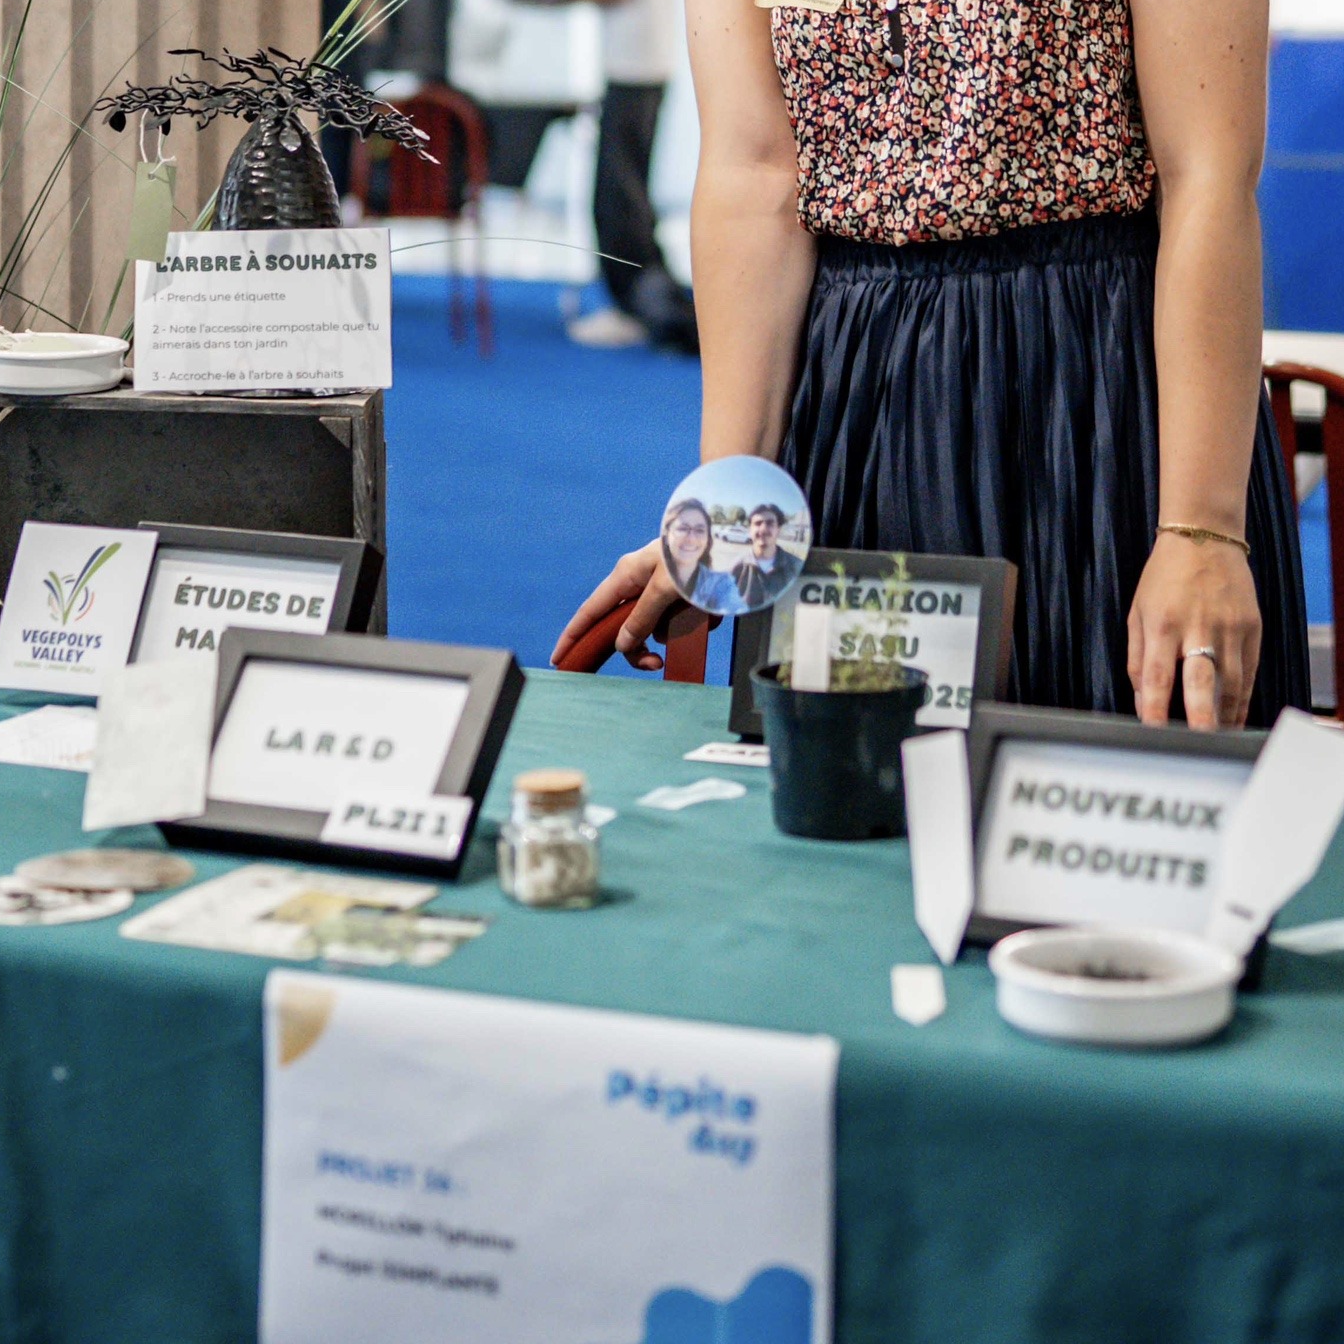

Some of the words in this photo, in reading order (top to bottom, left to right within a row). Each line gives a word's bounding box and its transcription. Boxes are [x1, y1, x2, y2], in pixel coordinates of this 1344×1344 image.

[246, 250, 260, 272] À
[265, 253, 378, 271] SOUHAITS
[167, 292, 206, 303] Prends
[209, 294, 231, 302] une
[234, 291, 286, 304] étiquette
[169, 324, 197, 334] Note
[199, 323, 263, 334] l'accessoire
[265, 321, 340, 335] compostable
[342, 323, 365, 335] que
[367, 322, 380, 332] tu
[152, 340, 201, 350] aimerais
[203, 339, 231, 349] dans
[234, 340, 253, 349] ton
[254, 339, 288, 351] jardin
[169, 371, 236, 382] Accroche-le
[248, 370, 284, 380] l'arbre
[296, 370, 344, 380] souhaits
[174, 576, 282, 616] ÉTUDES
[285, 594, 325, 620] DE
[22, 629, 103, 649] VEGEPOLYS
[175, 626, 217, 652] MA
[31, 646, 85, 663] VALLEY
[1012, 779, 1224, 831] NOUVEAUX
[1006, 834, 1209, 888] PRODUITS
